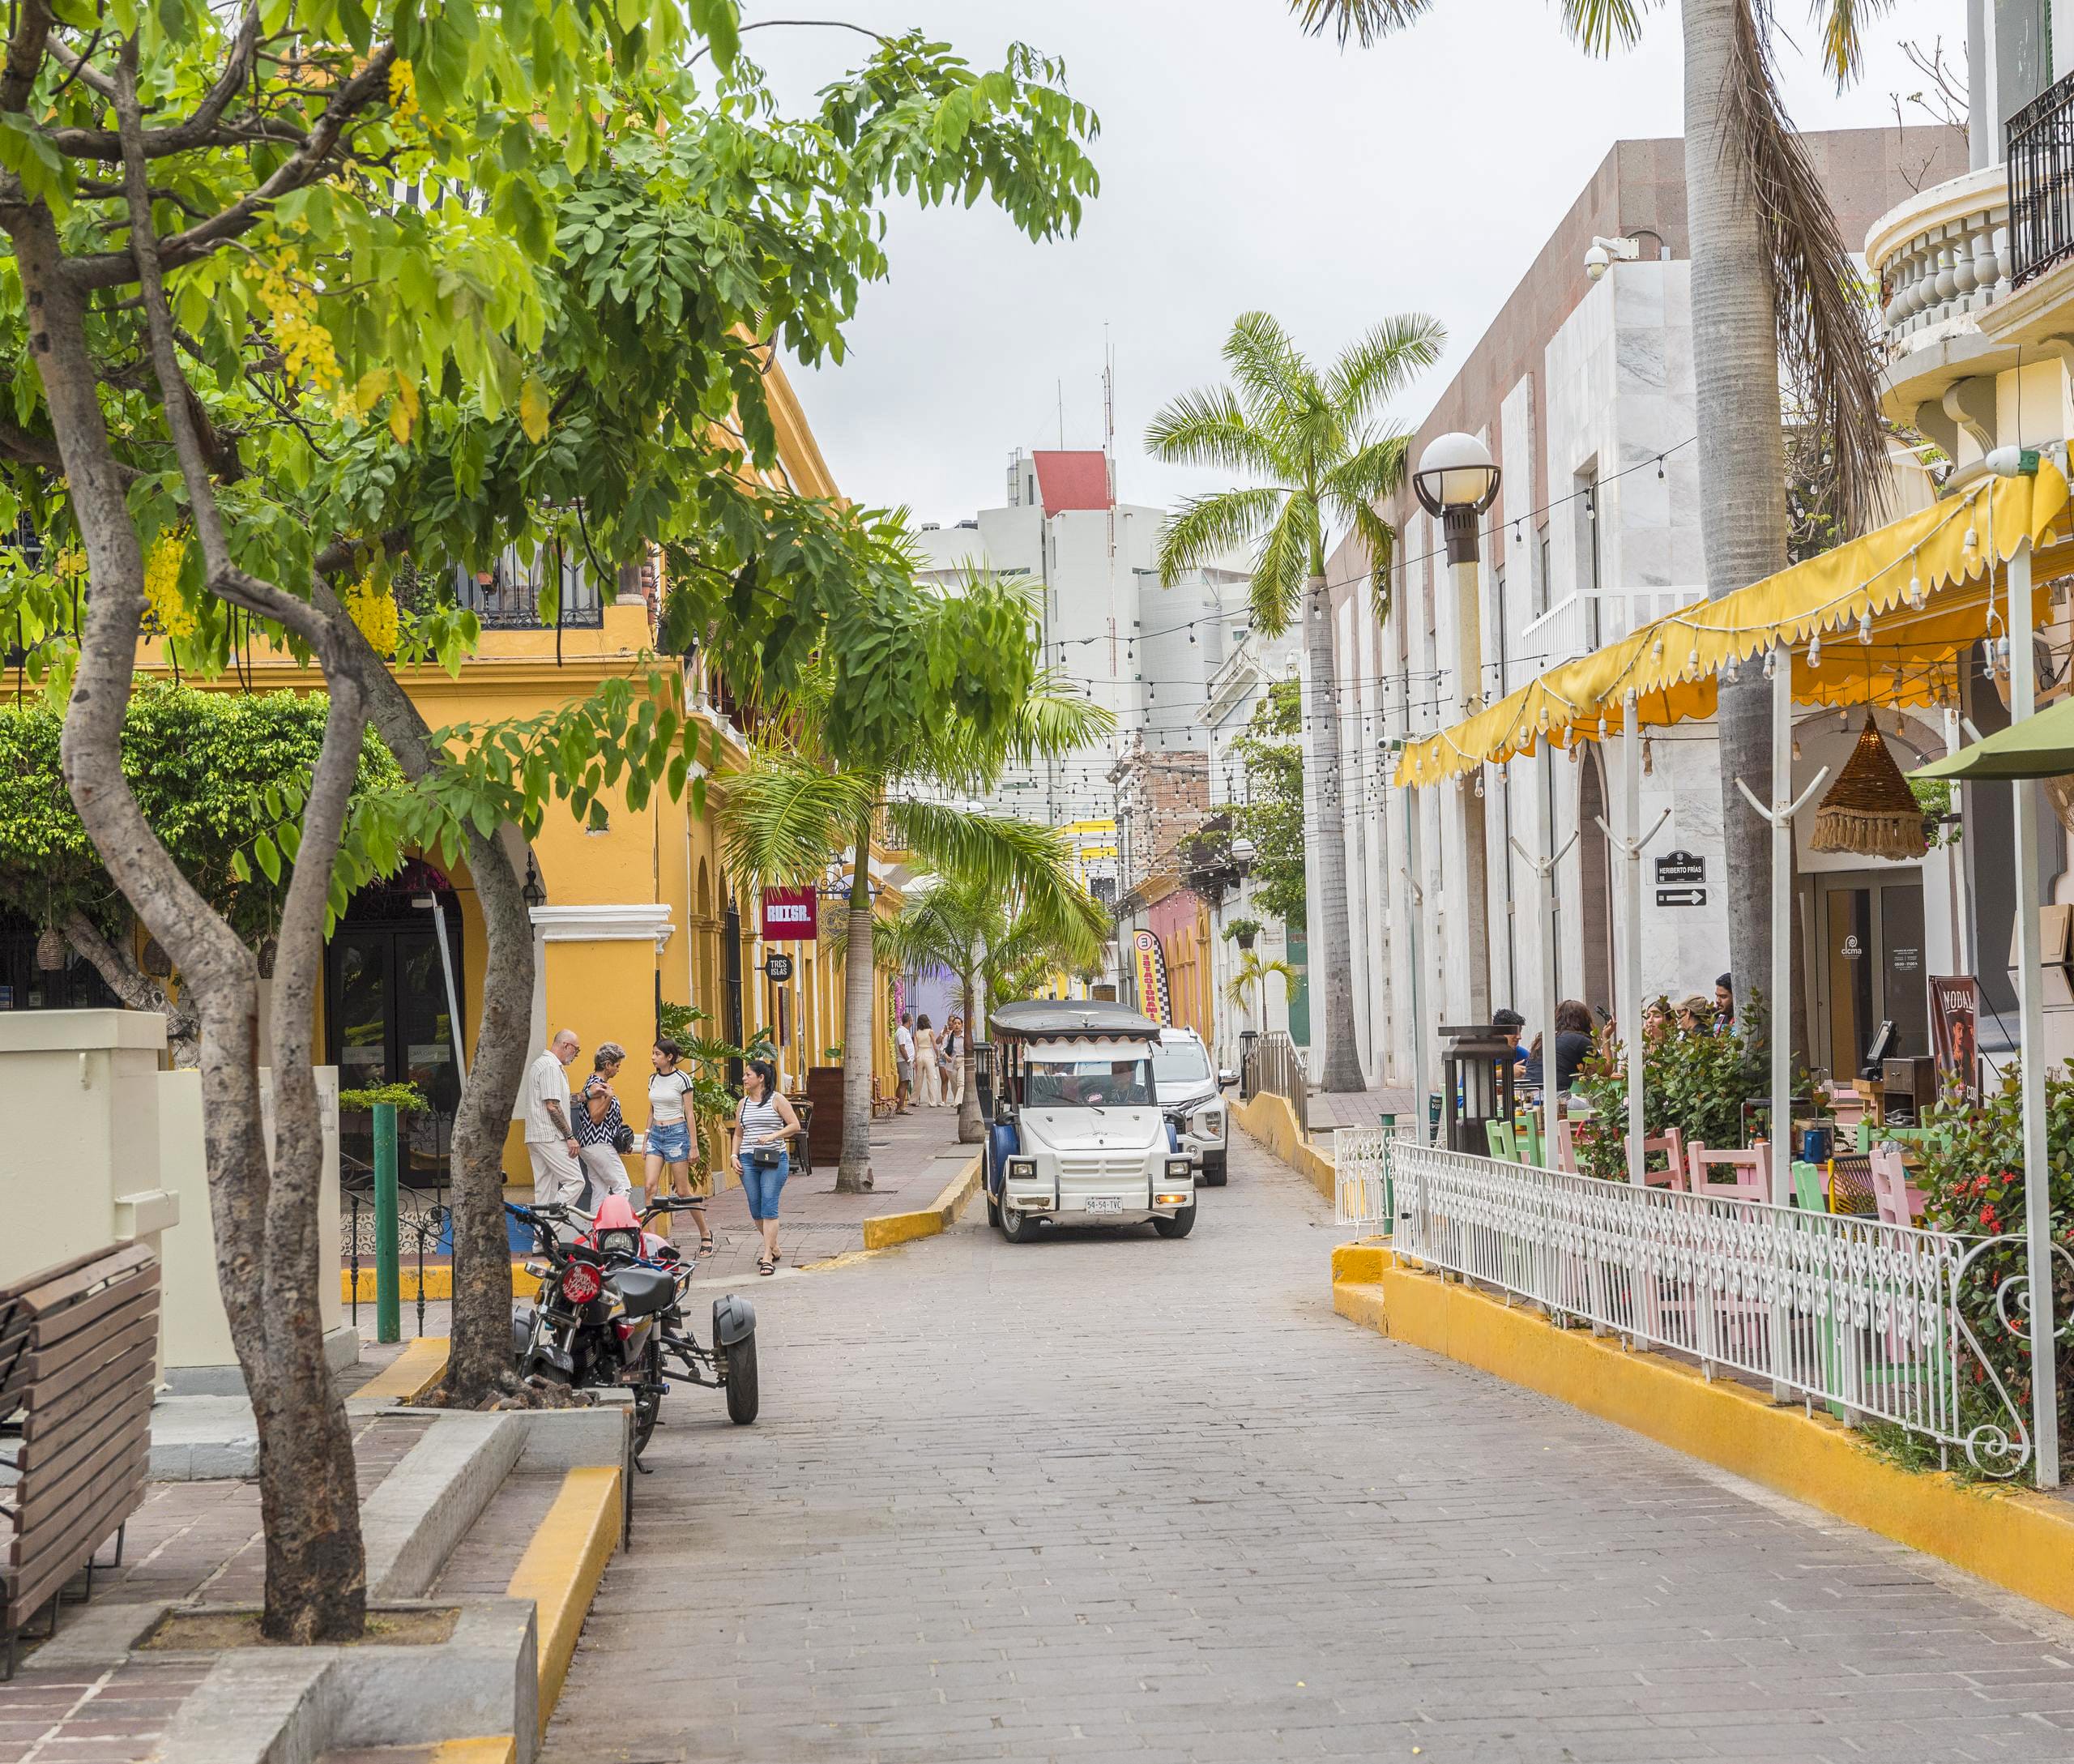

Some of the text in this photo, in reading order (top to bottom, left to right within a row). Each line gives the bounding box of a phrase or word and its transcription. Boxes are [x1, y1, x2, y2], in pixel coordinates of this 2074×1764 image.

[1687, 865, 1702, 873] FRÍAS
[770, 959, 787, 968] TRES
[770, 968, 787, 976] ISLAS
[1943, 990, 1974, 1010] NODAL
[1087, 1201, 1121, 1209] 54-54-TVC
